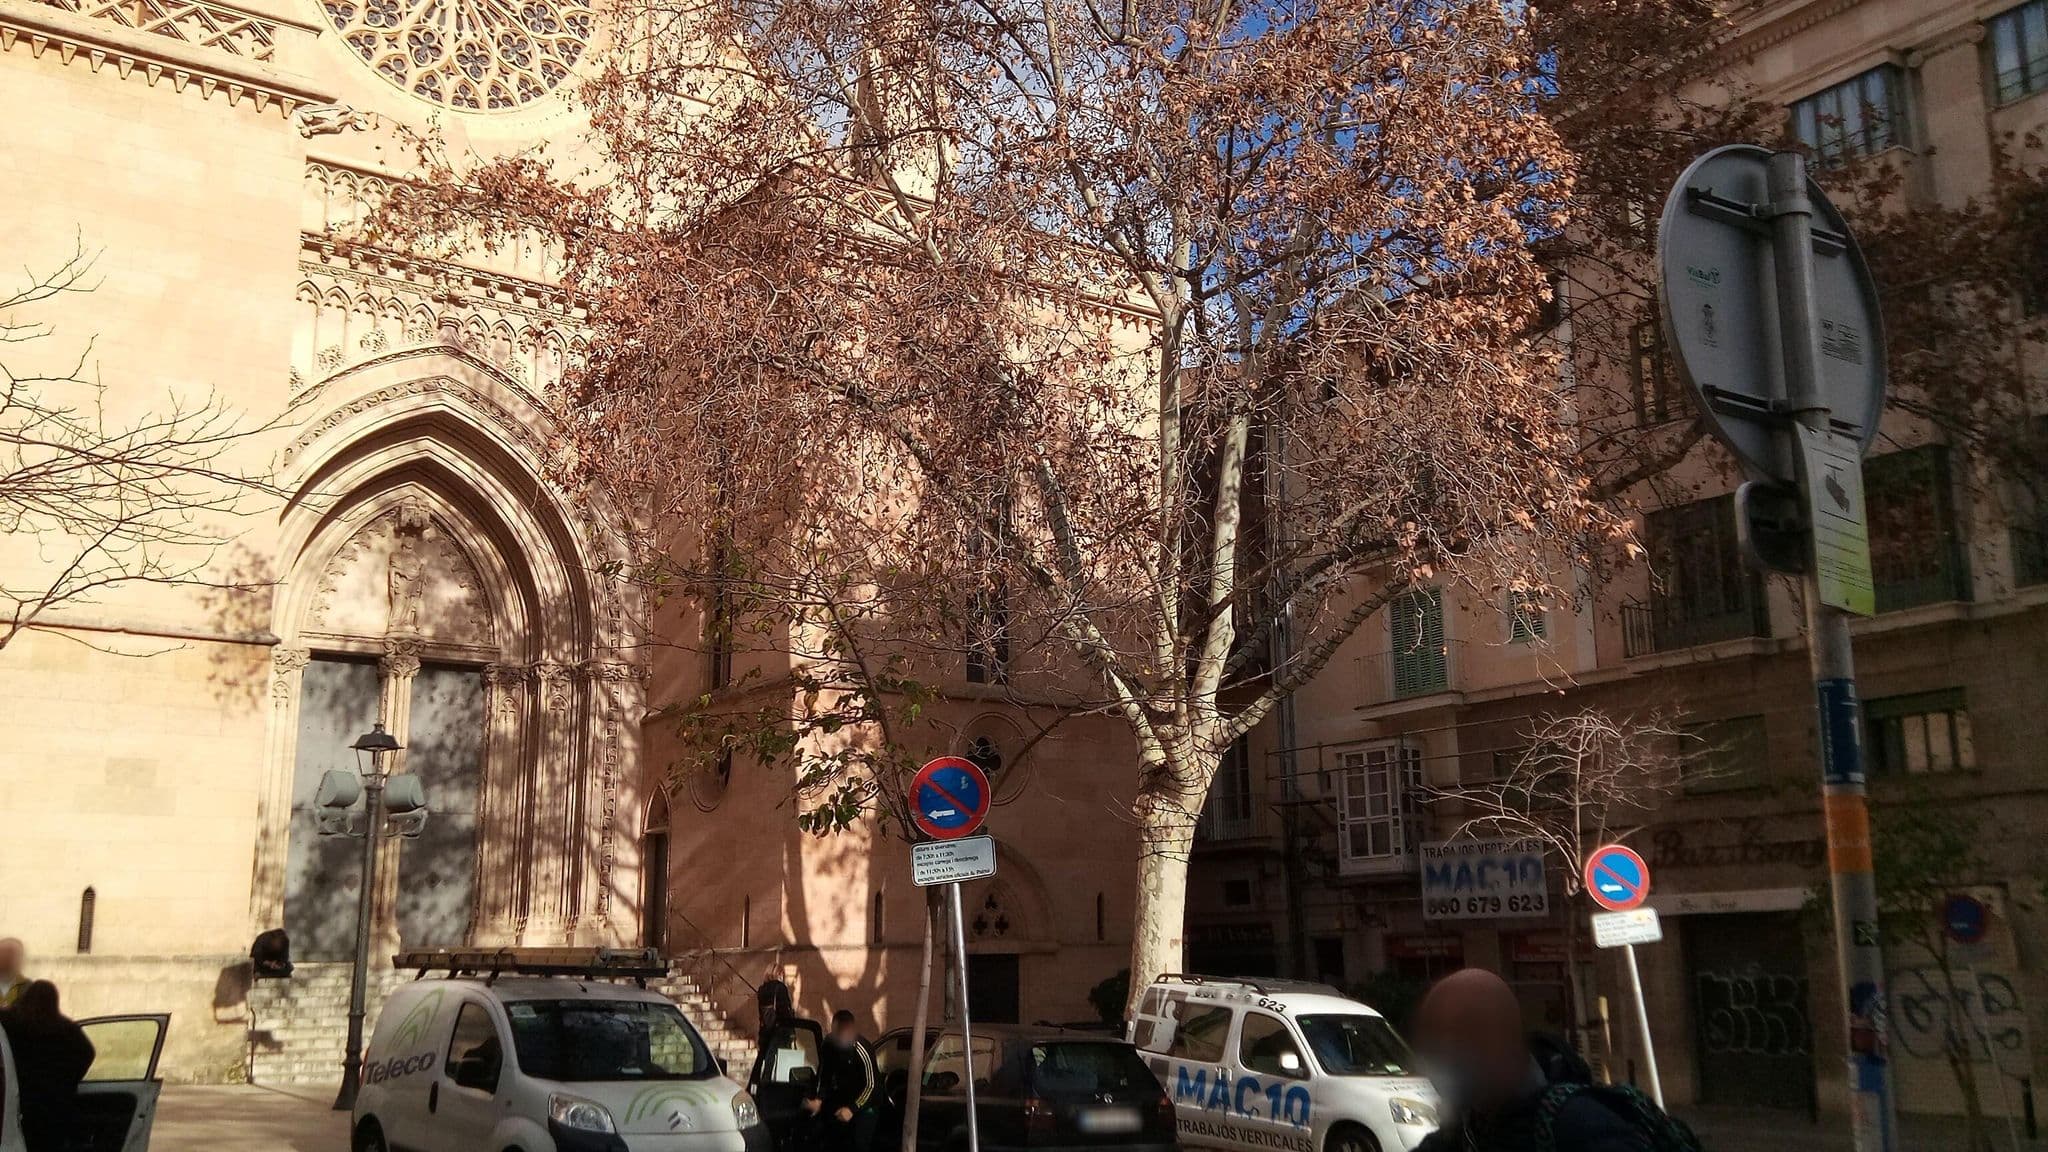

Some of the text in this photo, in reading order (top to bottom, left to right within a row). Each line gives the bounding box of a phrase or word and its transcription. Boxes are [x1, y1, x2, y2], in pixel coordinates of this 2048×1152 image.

[1425, 857, 1542, 891] MAC10
[1467, 896, 1501, 914] 679
[1508, 894, 1545, 912] 623
[1258, 997, 1287, 1013] 623
[367, 1051, 437, 1085] Teleco
[1176, 1065, 1311, 1128] MAC10
[1177, 1119, 1314, 1152] TRABAJOS VERTICALES
